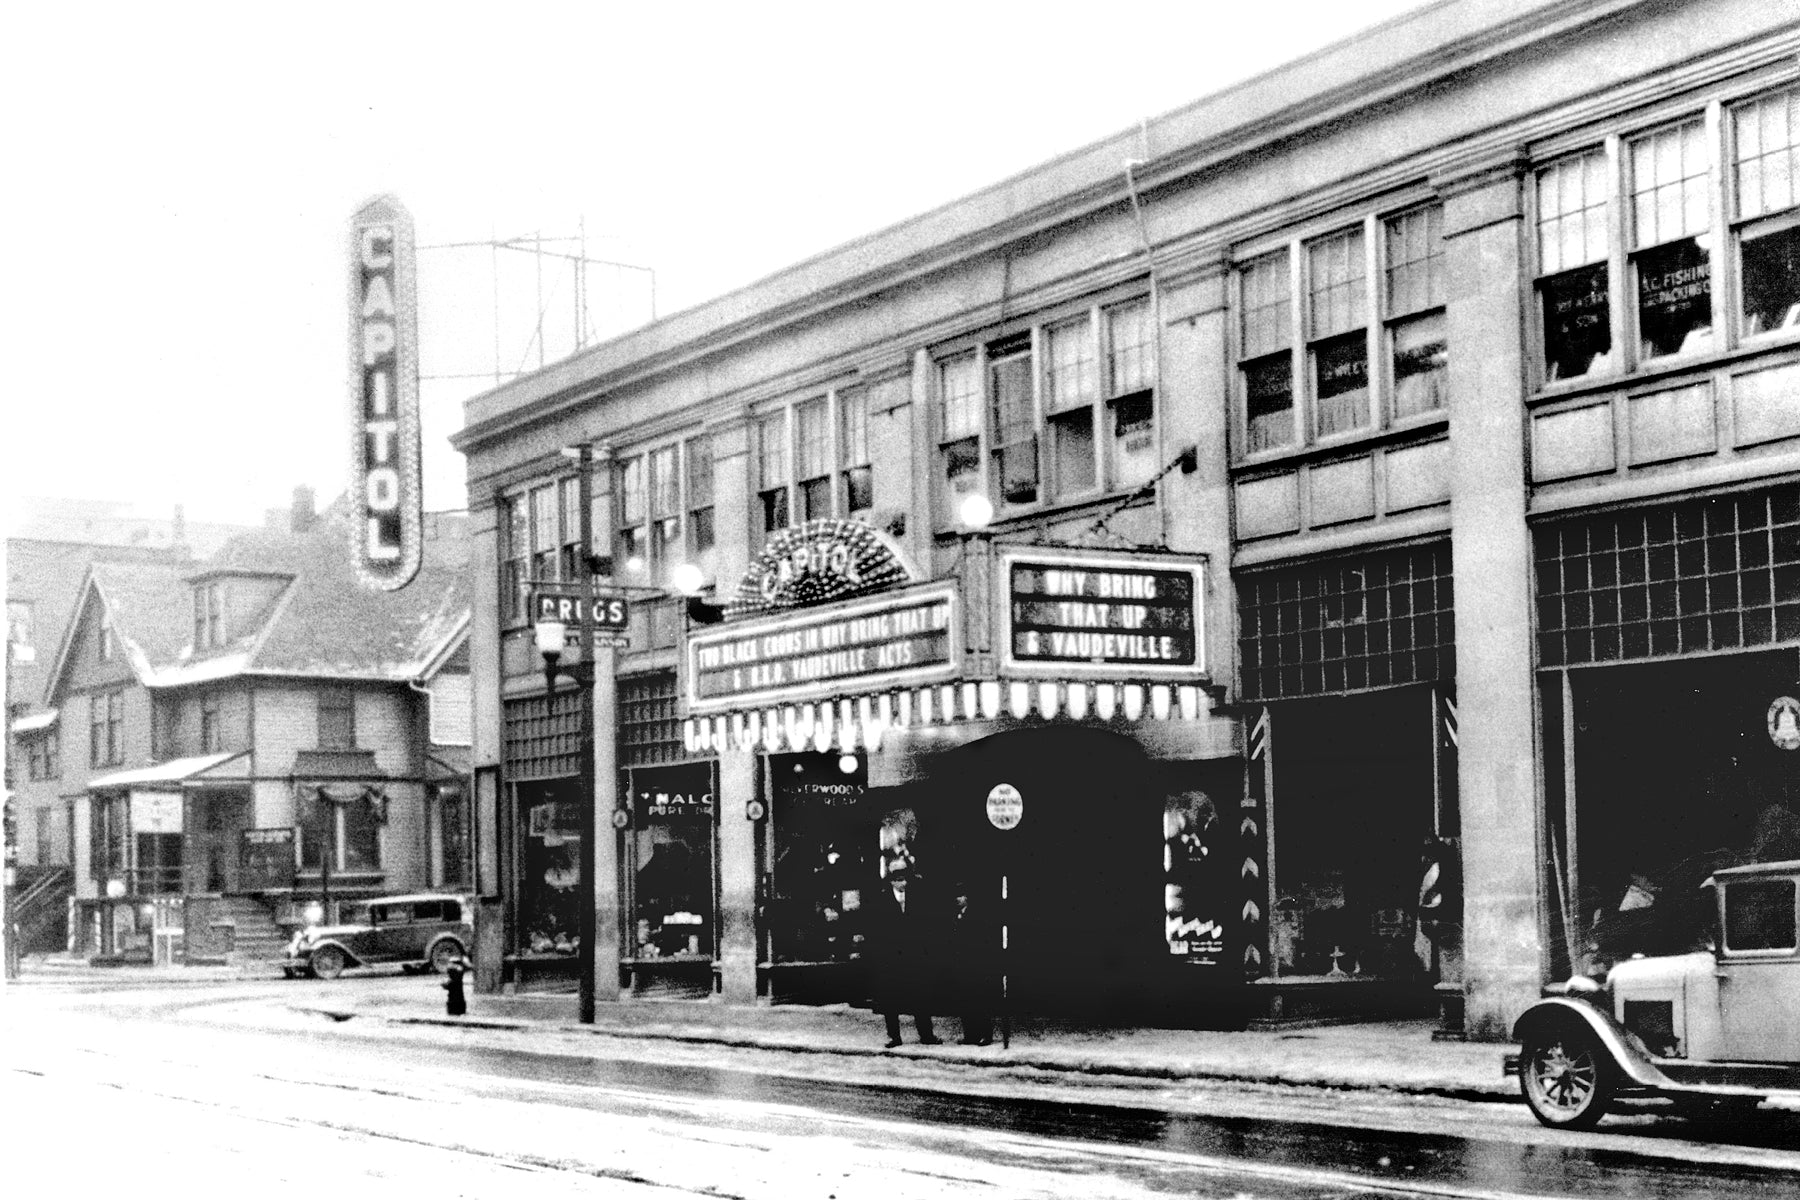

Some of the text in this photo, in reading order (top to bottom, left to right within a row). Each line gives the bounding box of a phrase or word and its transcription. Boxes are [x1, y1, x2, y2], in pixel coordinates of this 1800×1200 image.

[361, 227, 400, 559] CAPITOL
[1045, 570, 1156, 599] WHY BRING
[1059, 602, 1147, 629] THAT UP
[699, 646, 720, 669] TWO
[723, 639, 757, 664] BLACK
[764, 631, 802, 657] CROWS
[806, 628, 818, 650] IN
[822, 623, 847, 649] WHY
[850, 614, 889, 643] BRING
[894, 607, 928, 635] THAT
[1052, 632, 1172, 660] VAUDEVILLE
[792, 648, 866, 680] VAUDEVILLE
[878, 641, 912, 667] ACTS
